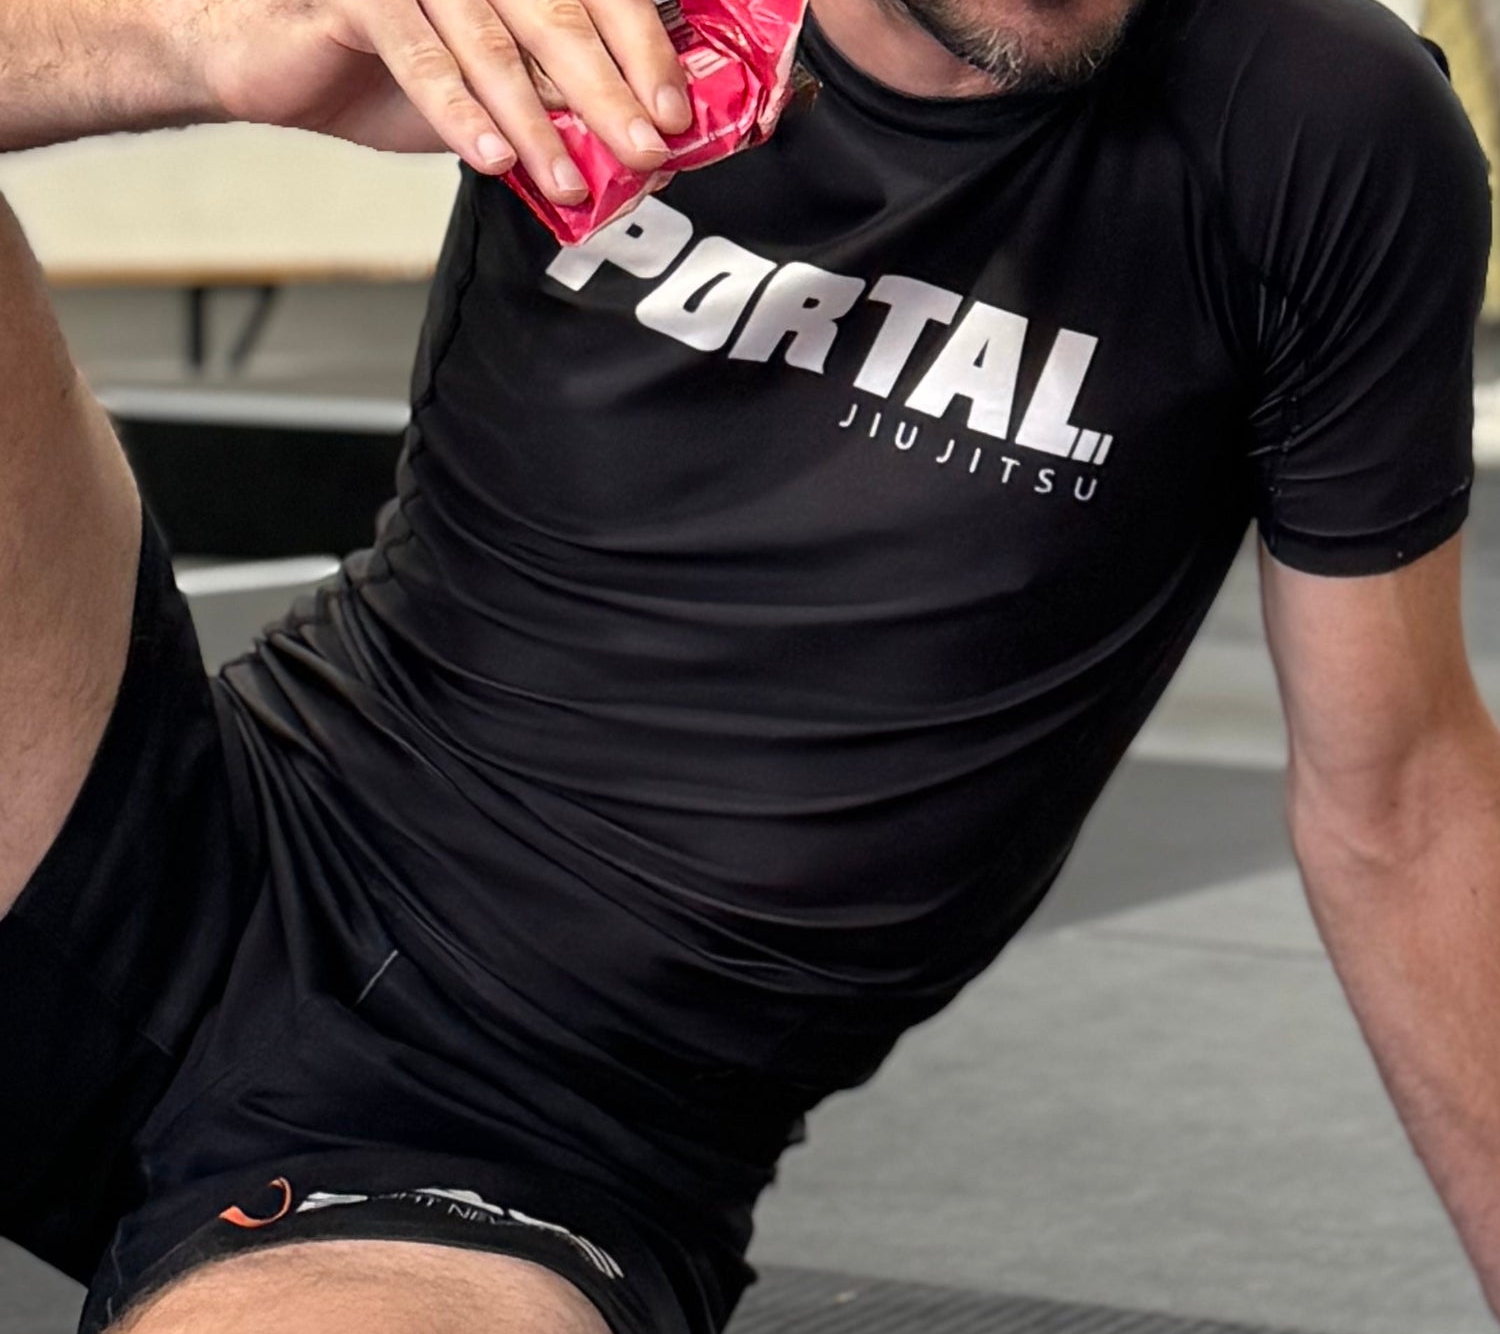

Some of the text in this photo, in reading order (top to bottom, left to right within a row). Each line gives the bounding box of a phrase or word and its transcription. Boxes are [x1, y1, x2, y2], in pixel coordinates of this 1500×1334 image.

[545, 193, 1105, 464] PORTAL
[838, 403, 1098, 503] JIU JITSU
